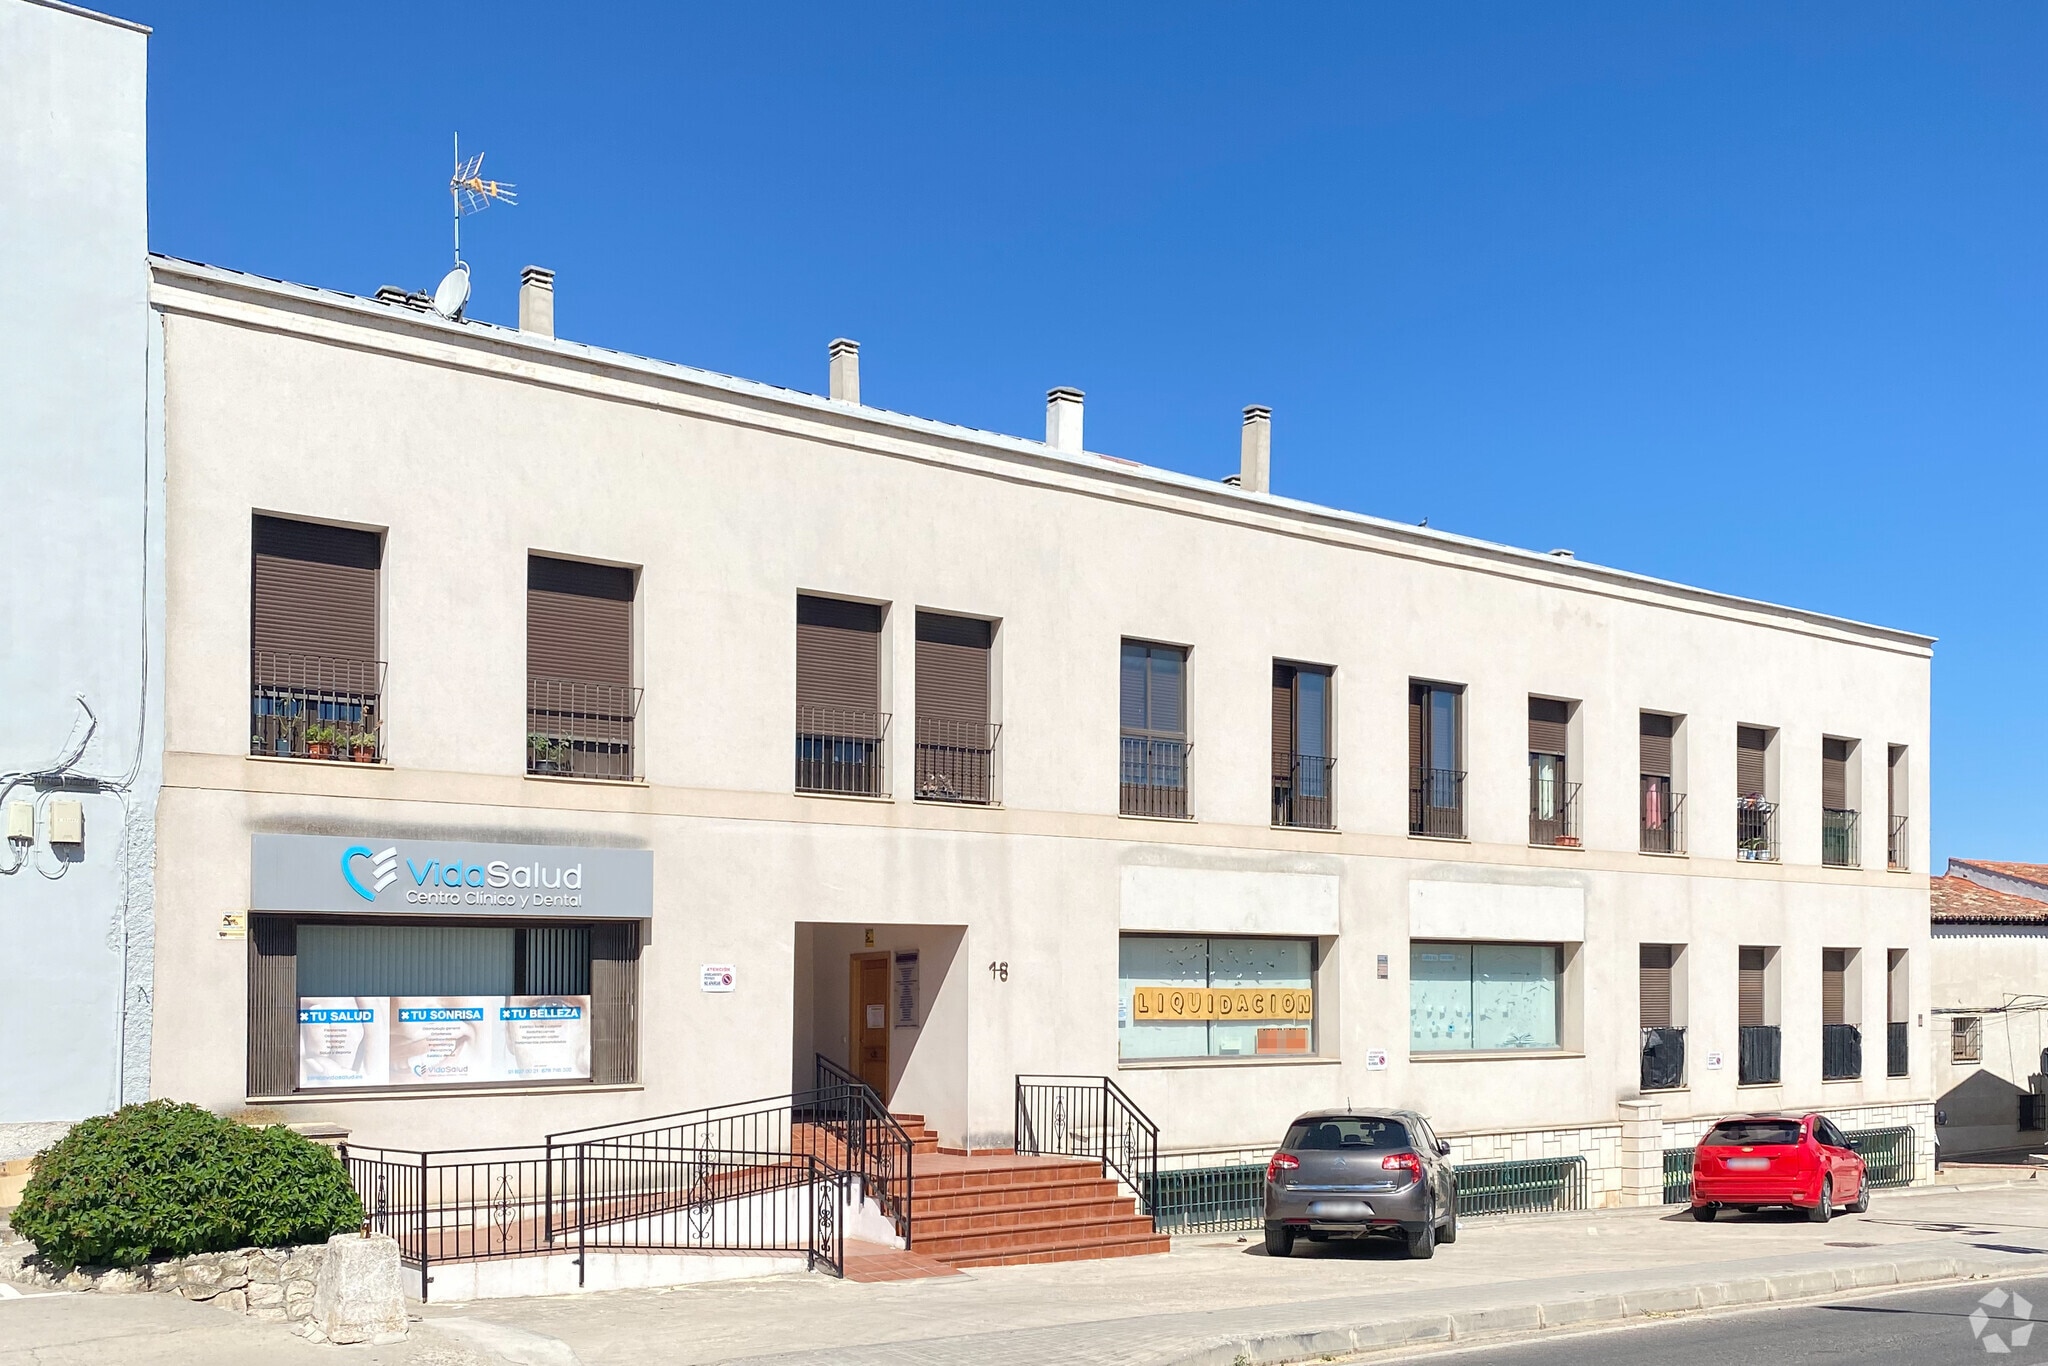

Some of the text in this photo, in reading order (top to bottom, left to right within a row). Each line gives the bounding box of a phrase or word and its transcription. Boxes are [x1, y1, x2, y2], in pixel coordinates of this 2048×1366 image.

[406, 857, 582, 889] VidaSalud
[406, 889, 582, 909] Centro Clínico y Dental
[988, 961, 1009, 983] 18
[1138, 991, 1311, 1015] LIQUIDACIÓN
[330, 1011, 372, 1021] SALUD
[430, 1010, 481, 1020] SONRISA
[529, 1009, 579, 1018] BELLEZA
